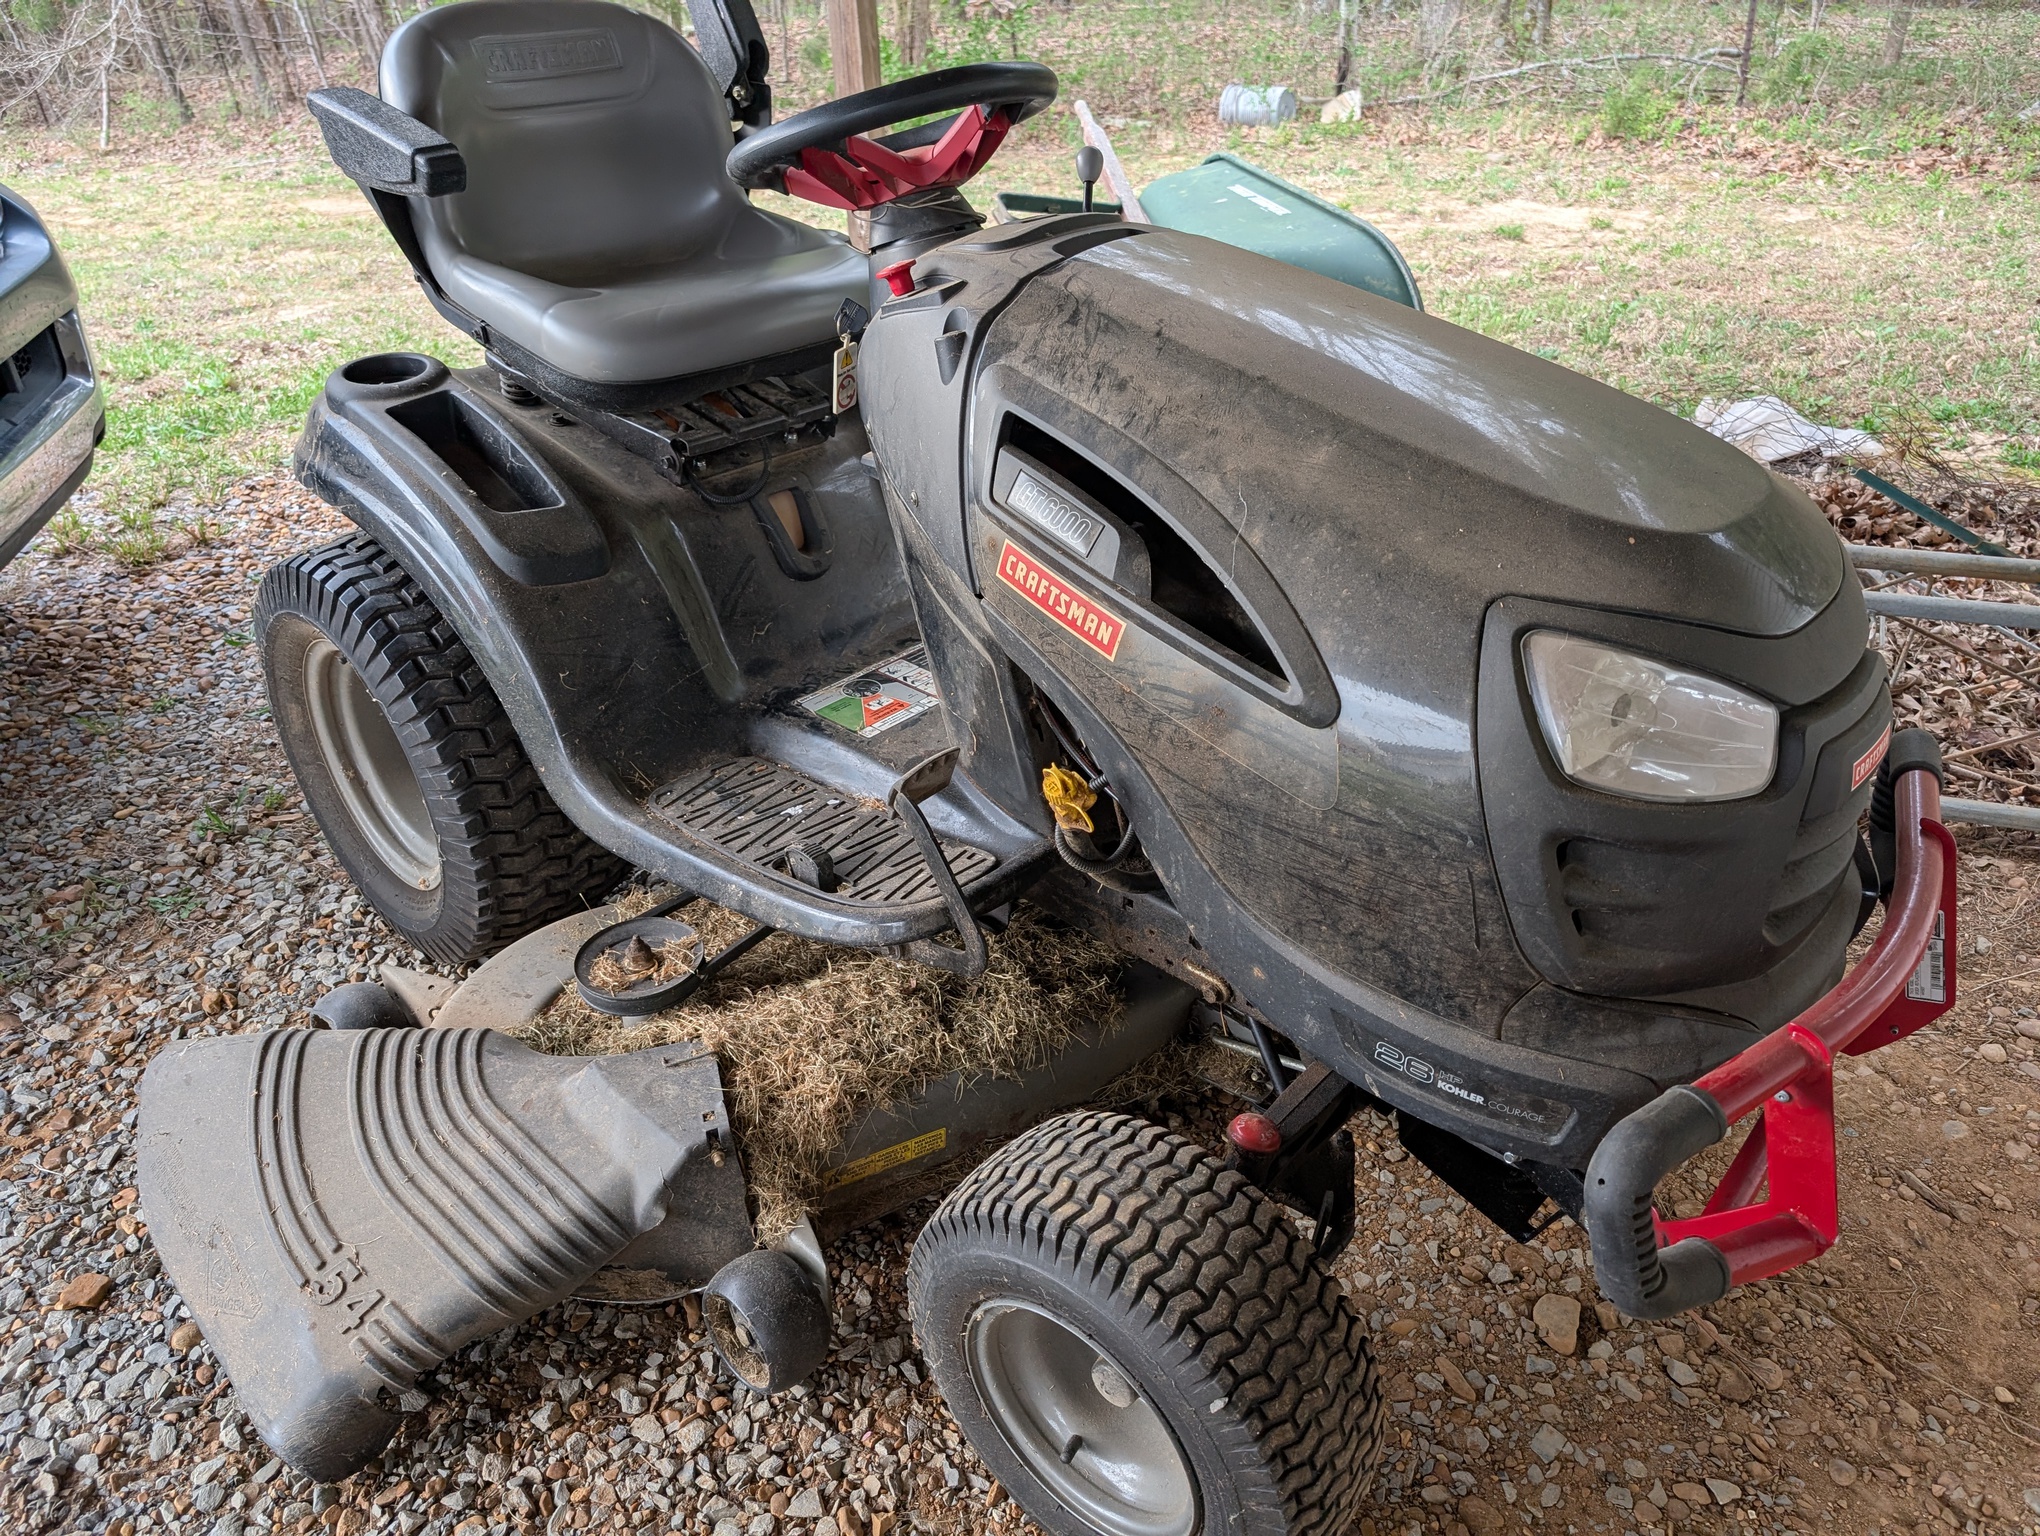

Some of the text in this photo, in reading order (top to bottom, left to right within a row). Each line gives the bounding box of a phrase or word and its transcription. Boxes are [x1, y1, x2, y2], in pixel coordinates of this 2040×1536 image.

[1005, 554, 1113, 646] CRAFTSMAN
[1437, 1080, 1546, 1124] KOHLER COURAGE
[1438, 1069, 1464, 1085] HP
[311, 1257, 385, 1335] 54
